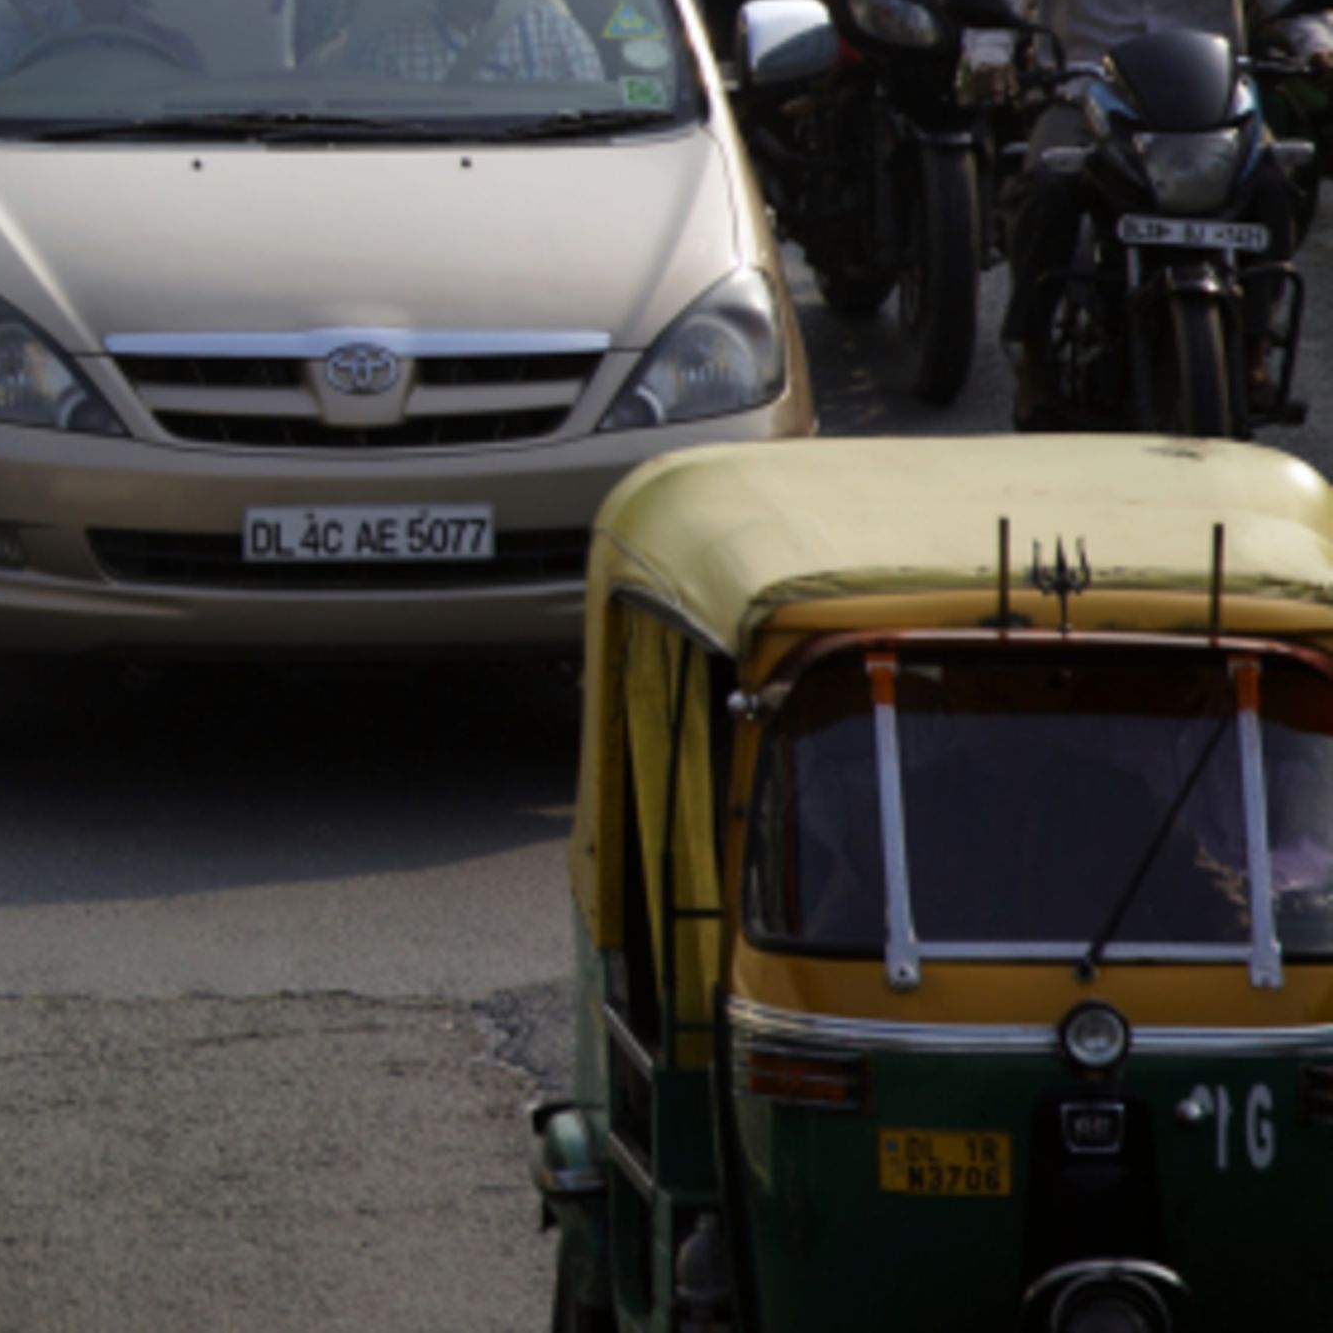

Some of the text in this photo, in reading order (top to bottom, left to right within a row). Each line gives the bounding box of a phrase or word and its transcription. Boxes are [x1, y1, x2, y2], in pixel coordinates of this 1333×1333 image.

[251, 517, 487, 556] DL 4C AE 5077
[907, 1135, 941, 1163] DL
